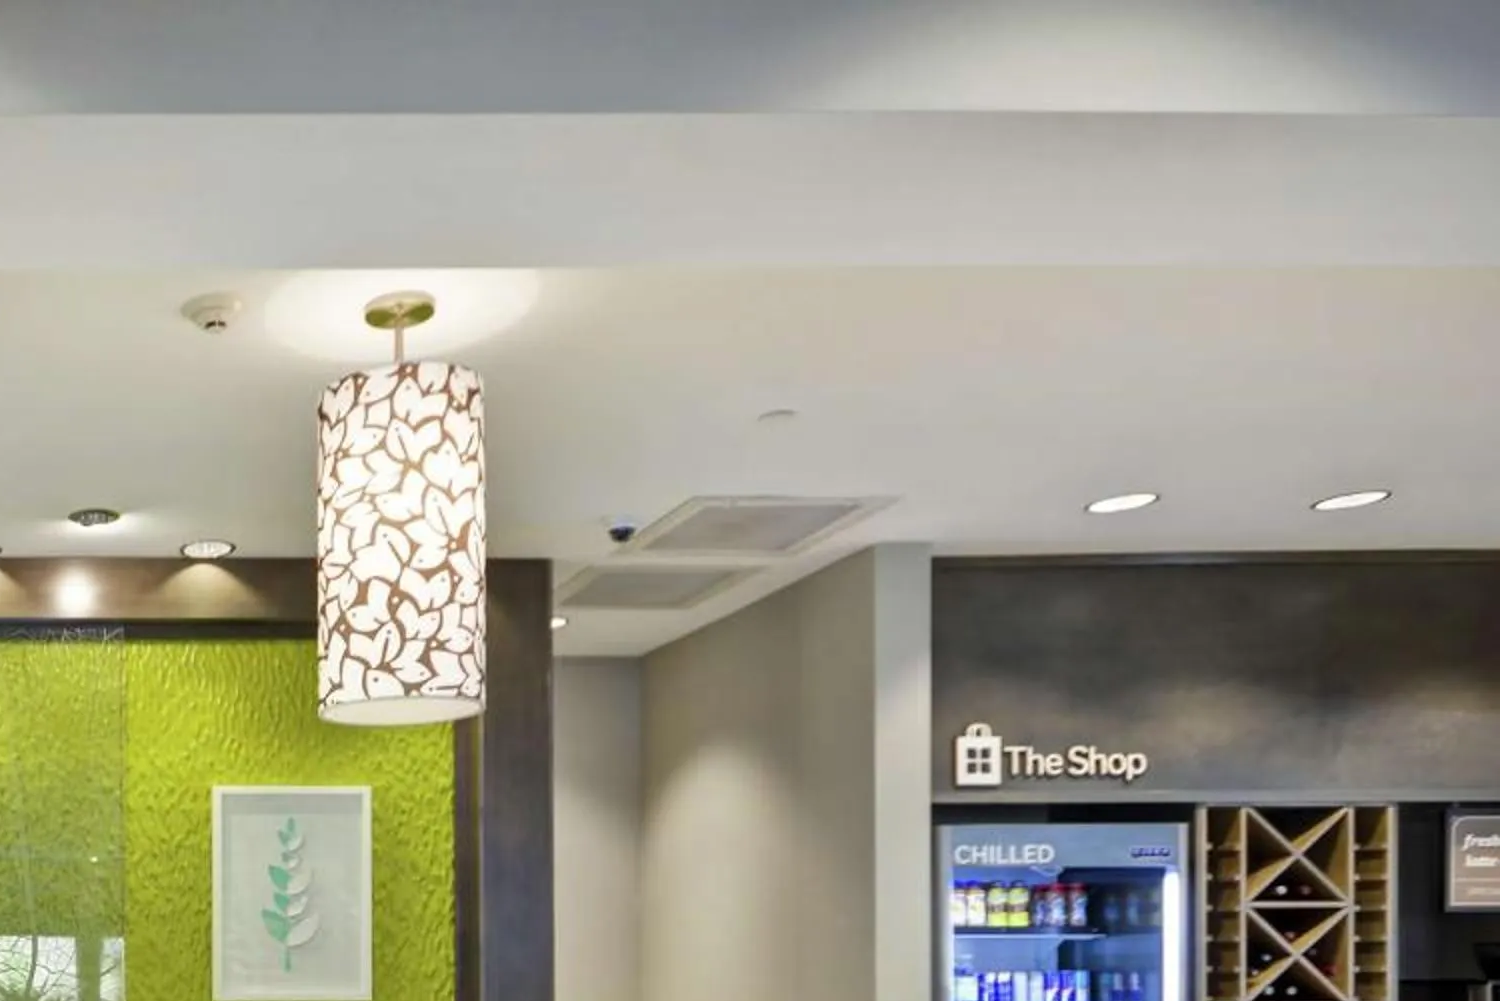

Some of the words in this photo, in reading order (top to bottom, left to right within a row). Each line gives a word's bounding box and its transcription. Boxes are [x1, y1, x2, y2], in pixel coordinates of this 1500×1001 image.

[1003, 745, 1064, 776] The
[1067, 745, 1148, 781] Shop
[954, 844, 1055, 865] CHILLED
